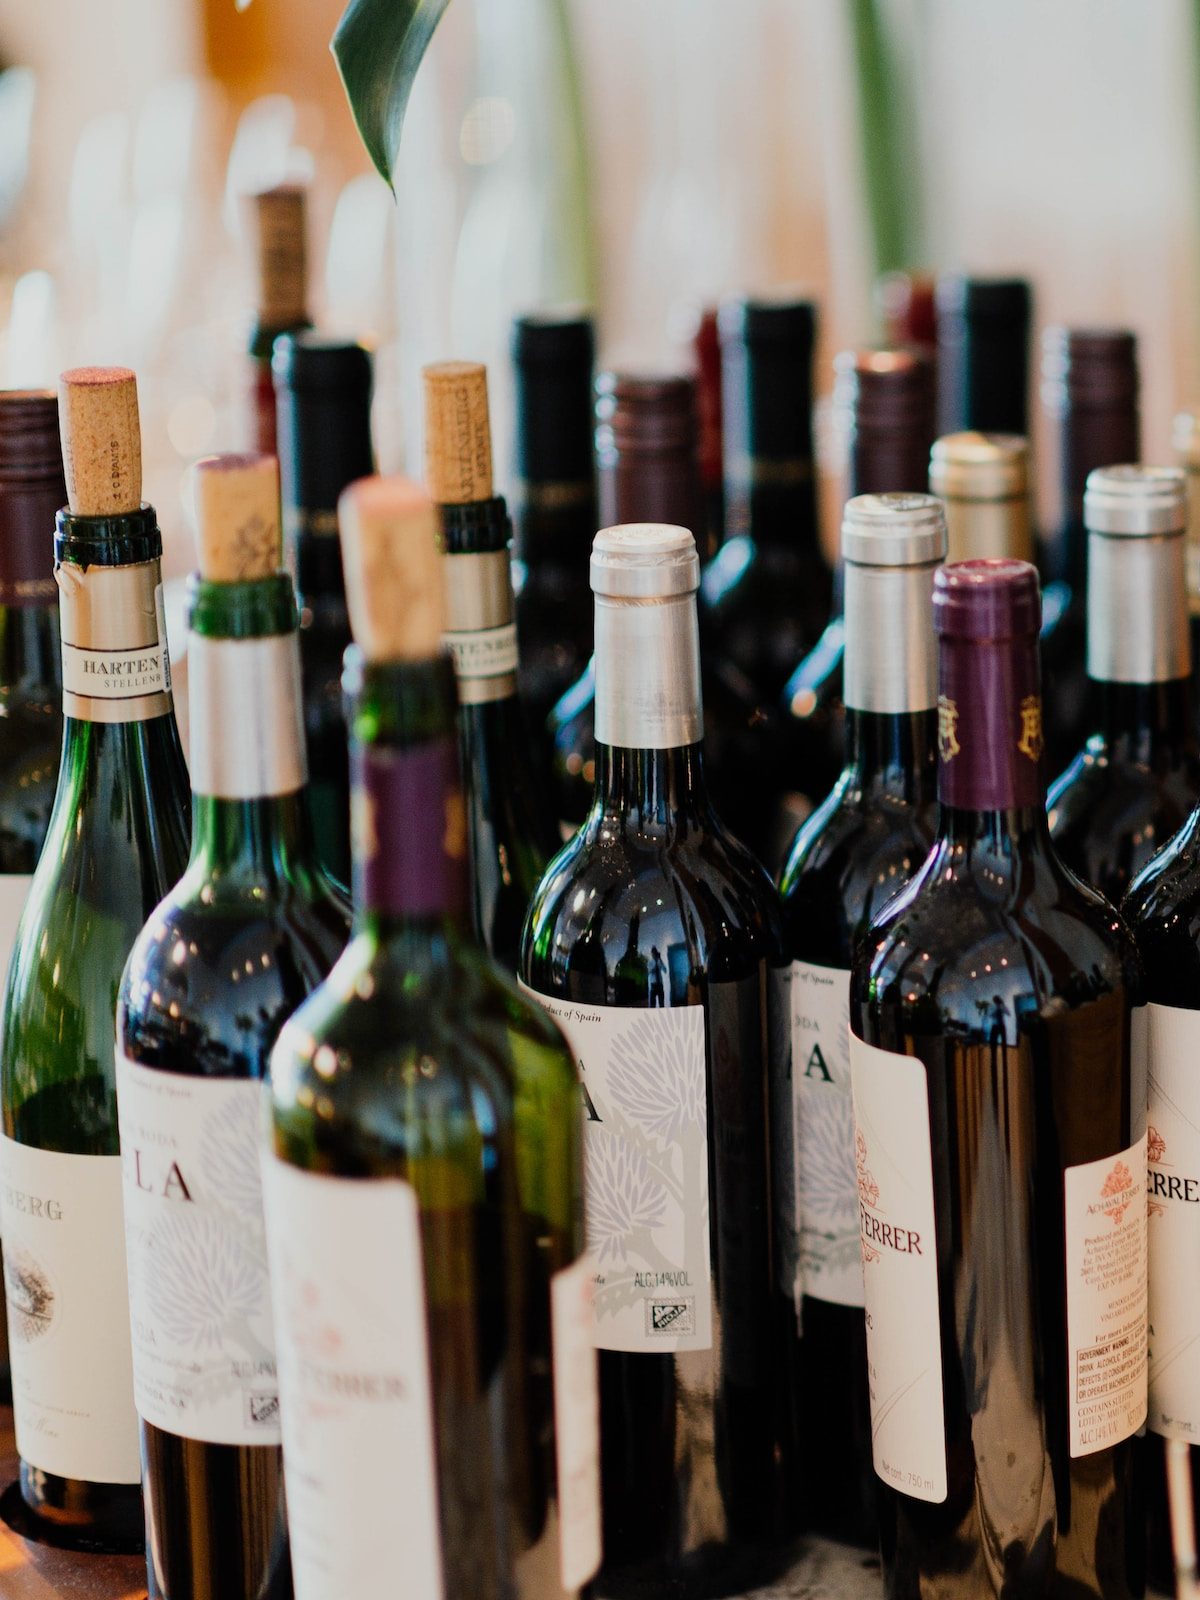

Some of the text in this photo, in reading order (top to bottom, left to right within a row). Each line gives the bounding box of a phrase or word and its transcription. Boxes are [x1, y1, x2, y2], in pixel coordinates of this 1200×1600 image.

[564, 1009, 574, 1020] of
[575, 1010, 602, 1023] Spain
[1079, 1343, 1110, 1361] GOVERNMENT
[1077, 1399, 1110, 1417] CONTAINS
[908, 1472, 923, 1489] 750
